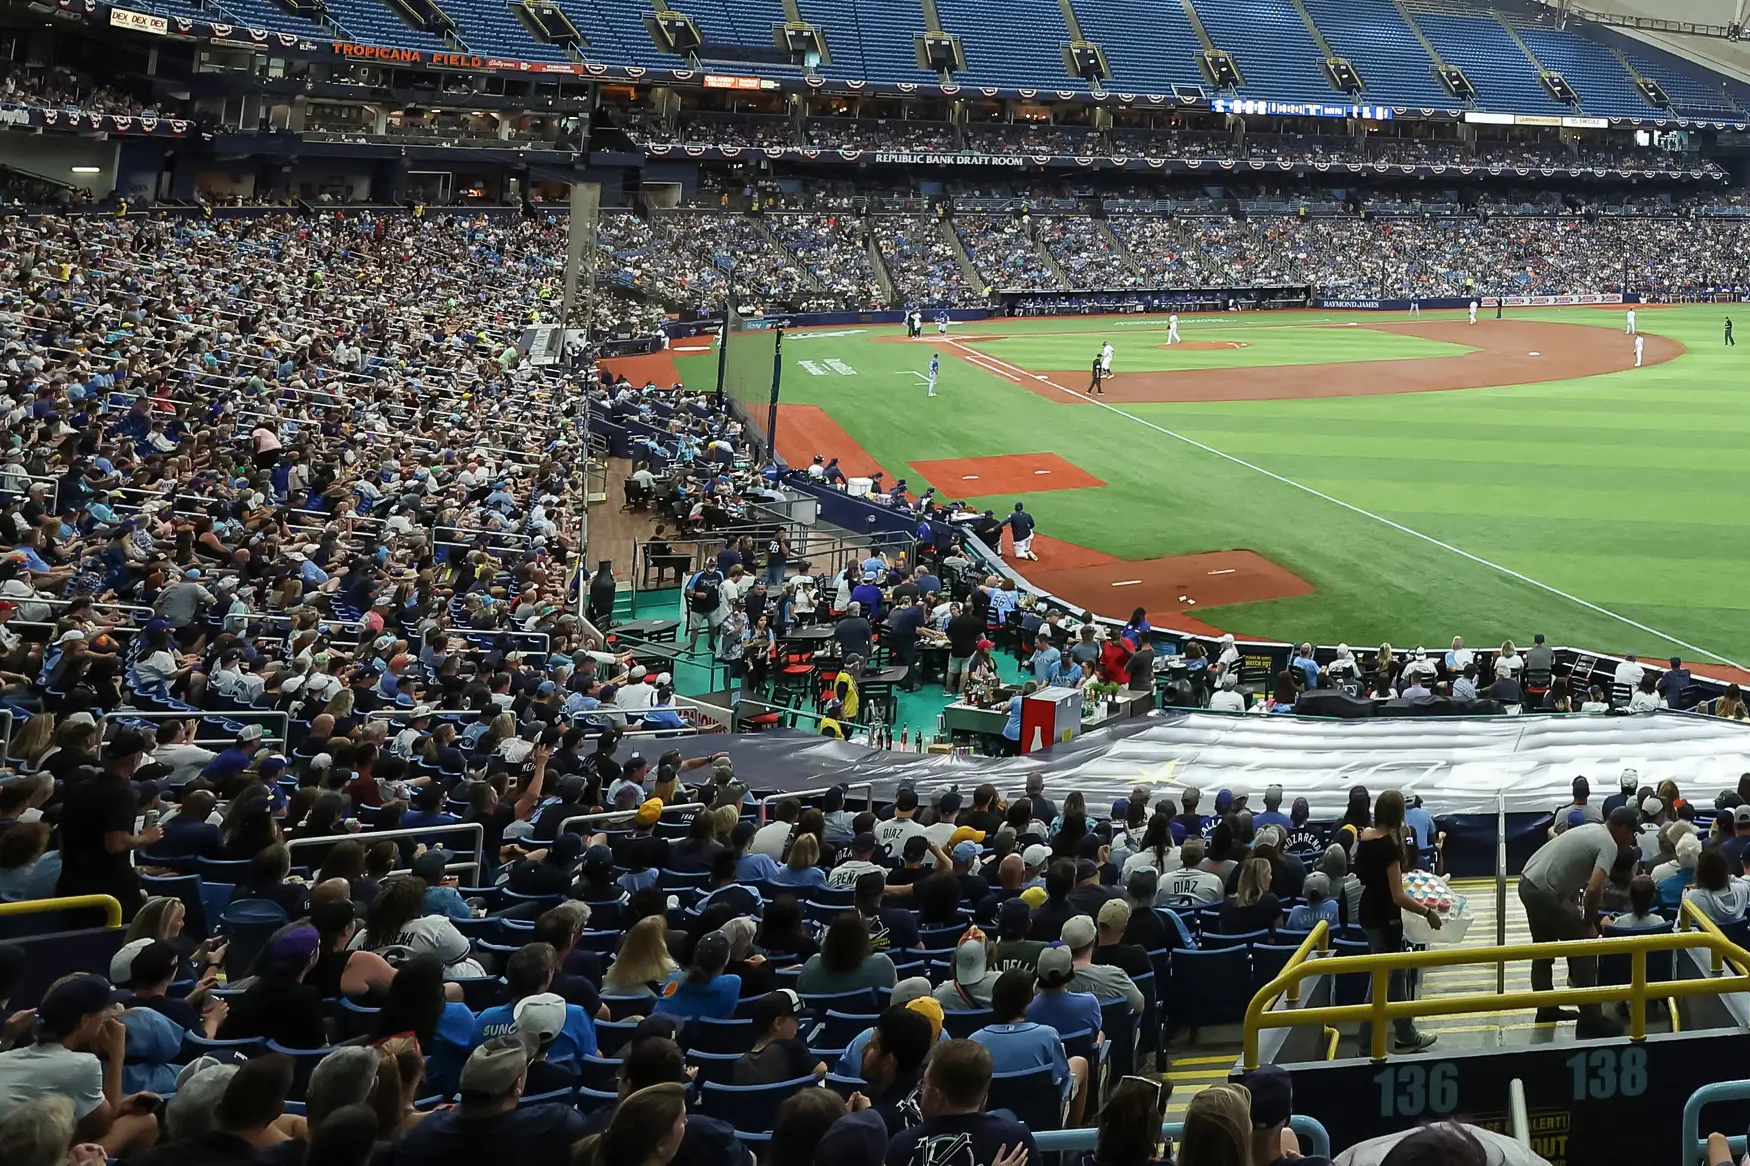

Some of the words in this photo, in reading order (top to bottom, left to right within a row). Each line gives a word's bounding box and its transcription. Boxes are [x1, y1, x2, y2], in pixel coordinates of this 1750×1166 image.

[112, 11, 128, 22] DEX
[131, 15, 147, 25] DEX
[150, 18, 166, 28] DEX
[332, 42, 421, 62] TROPICANA
[432, 53, 482, 67] FIELD
[876, 154, 925, 164] REPUBLIC
[926, 155, 954, 164] BANK
[956, 155, 989, 165] DRAFT
[991, 157, 1023, 166] ROOM
[1566, 1047, 1648, 1101] 138
[1373, 1062, 1459, 1117] 136
